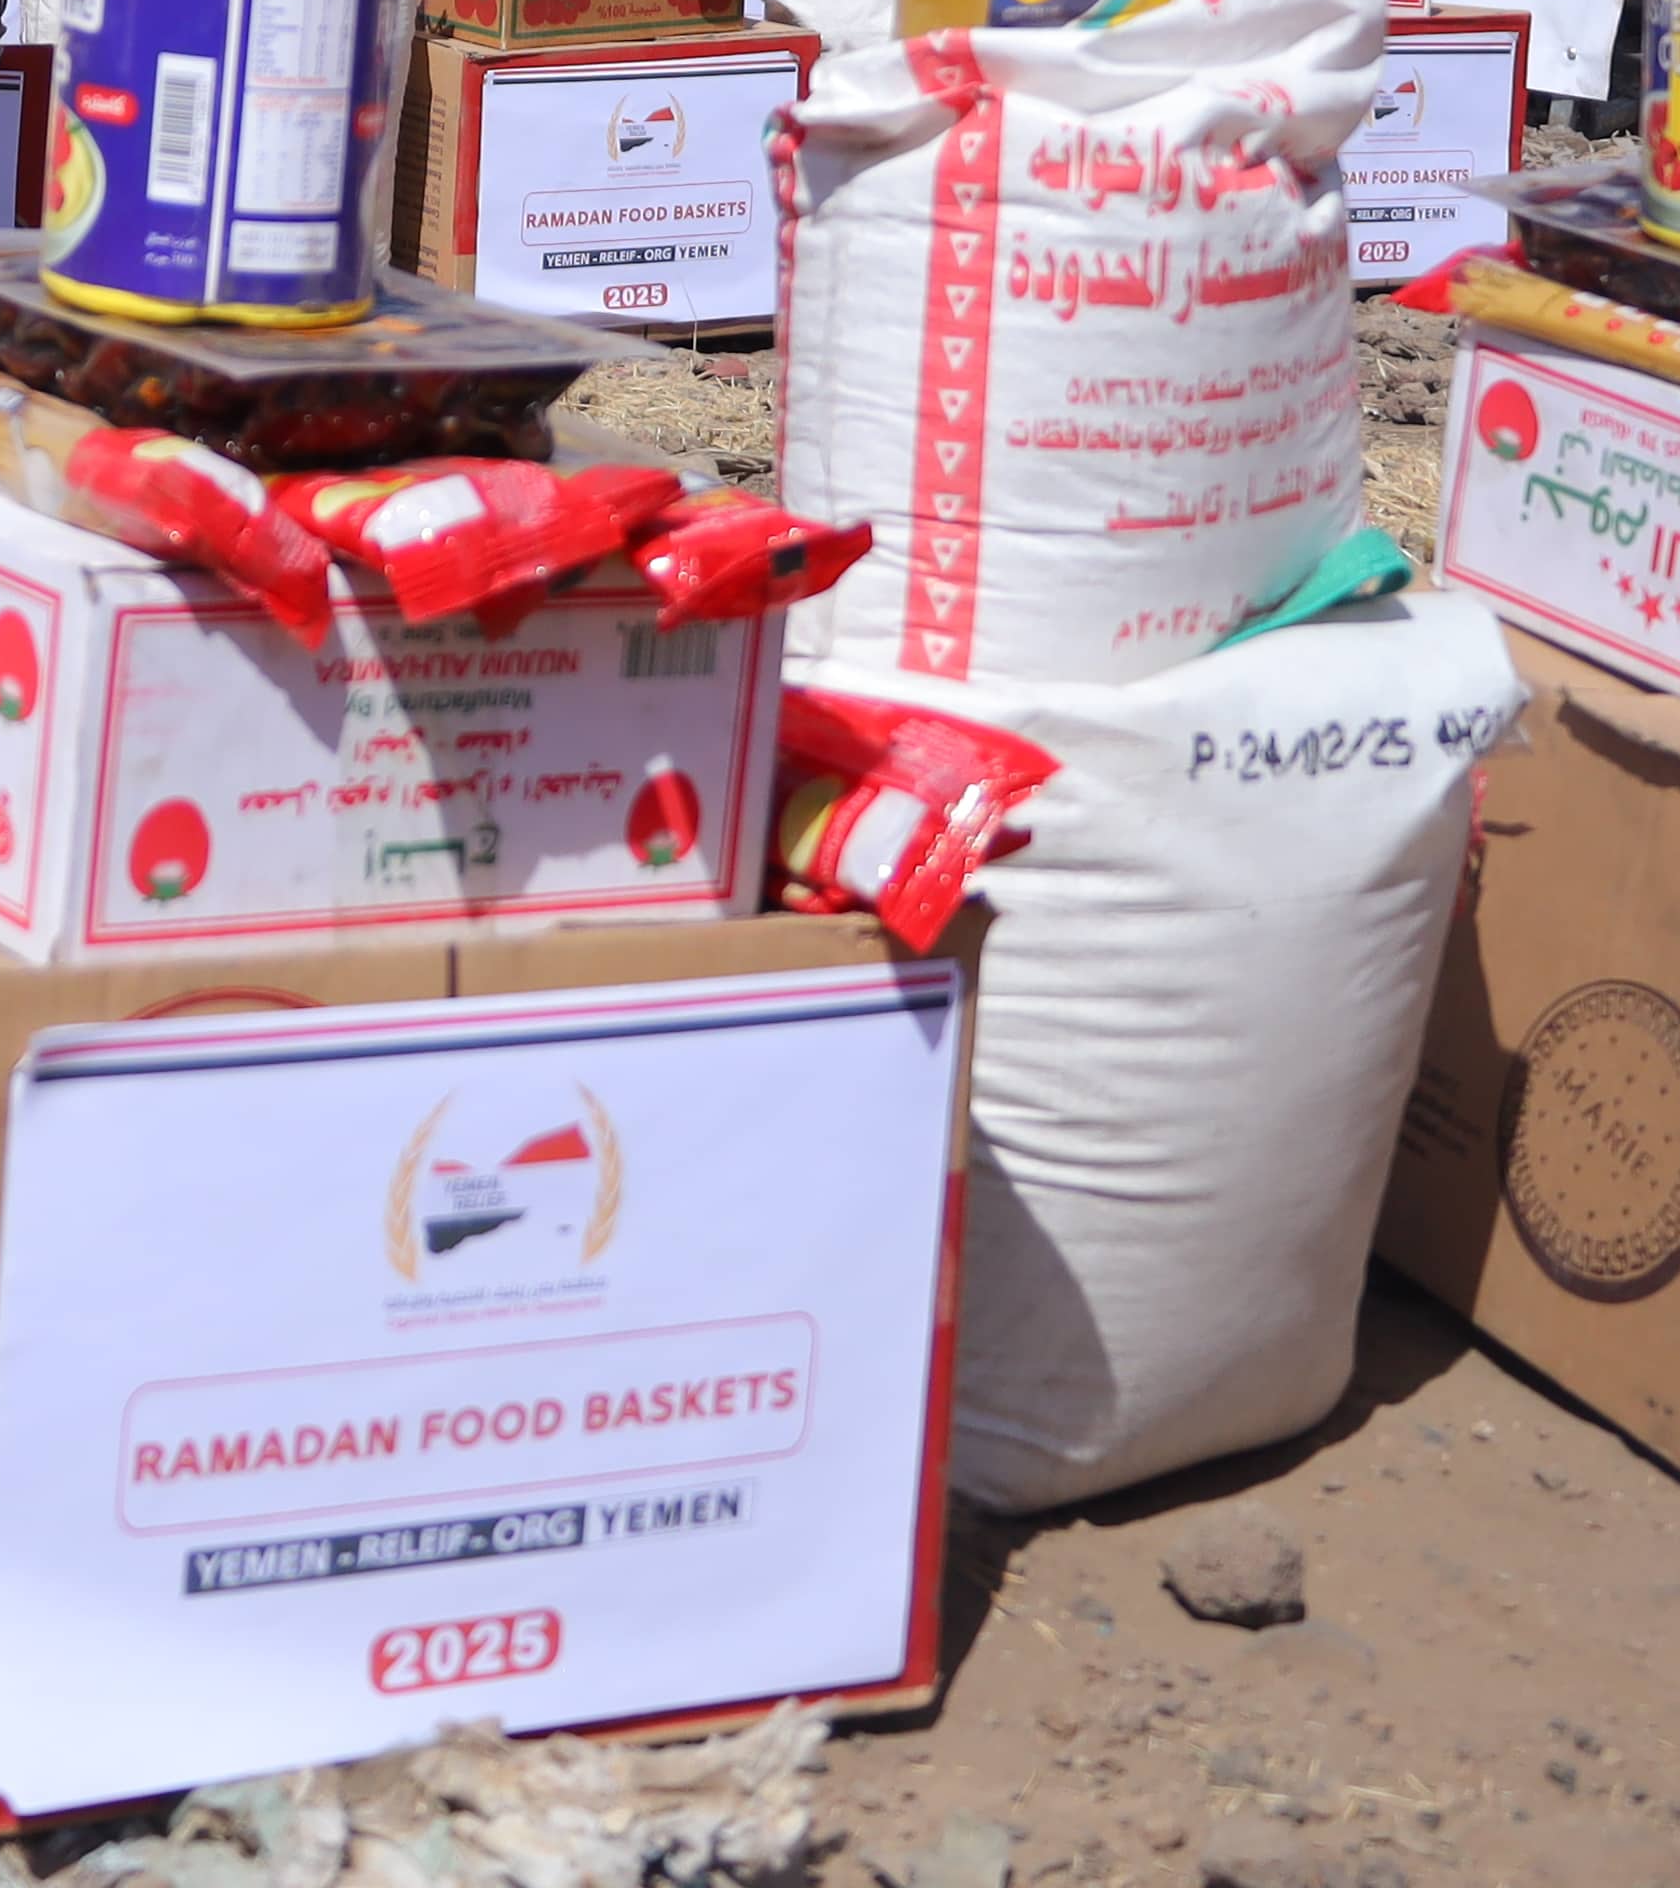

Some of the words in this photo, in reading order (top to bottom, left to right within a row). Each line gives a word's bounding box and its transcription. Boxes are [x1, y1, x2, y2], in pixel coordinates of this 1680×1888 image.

[1371, 169, 1409, 185] FOOD
[1413, 168, 1469, 184] BASKETS
[526, 209, 613, 228] RAMADAN
[618, 206, 668, 224] FOOD
[673, 200, 747, 221] BASKETS
[1391, 207, 1413, 220] ORG
[1418, 207, 1456, 220] YEMEN
[547, 253, 590, 267] YEMEN
[643, 247, 672, 262] ORG
[679, 244, 729, 259] YEMEN
[1361, 242, 1406, 261] 2025
[1007, 230, 1171, 323] المحدودة
[607, 284, 664, 308] 2025
[1520, 470, 1651, 547] نجوم
[317, 649, 475, 685] ALHAMRA
[481, 647, 581, 676] NUJUM
[132, 1416, 399, 1486] RAMADAN
[418, 1397, 564, 1453] FOOD
[581, 1368, 799, 1435] BASKETS
[194, 1539, 332, 1590] YEMEN
[491, 1509, 580, 1554] ORG
[597, 1486, 743, 1535] YEMEN
[380, 1612, 549, 1692] 2025
